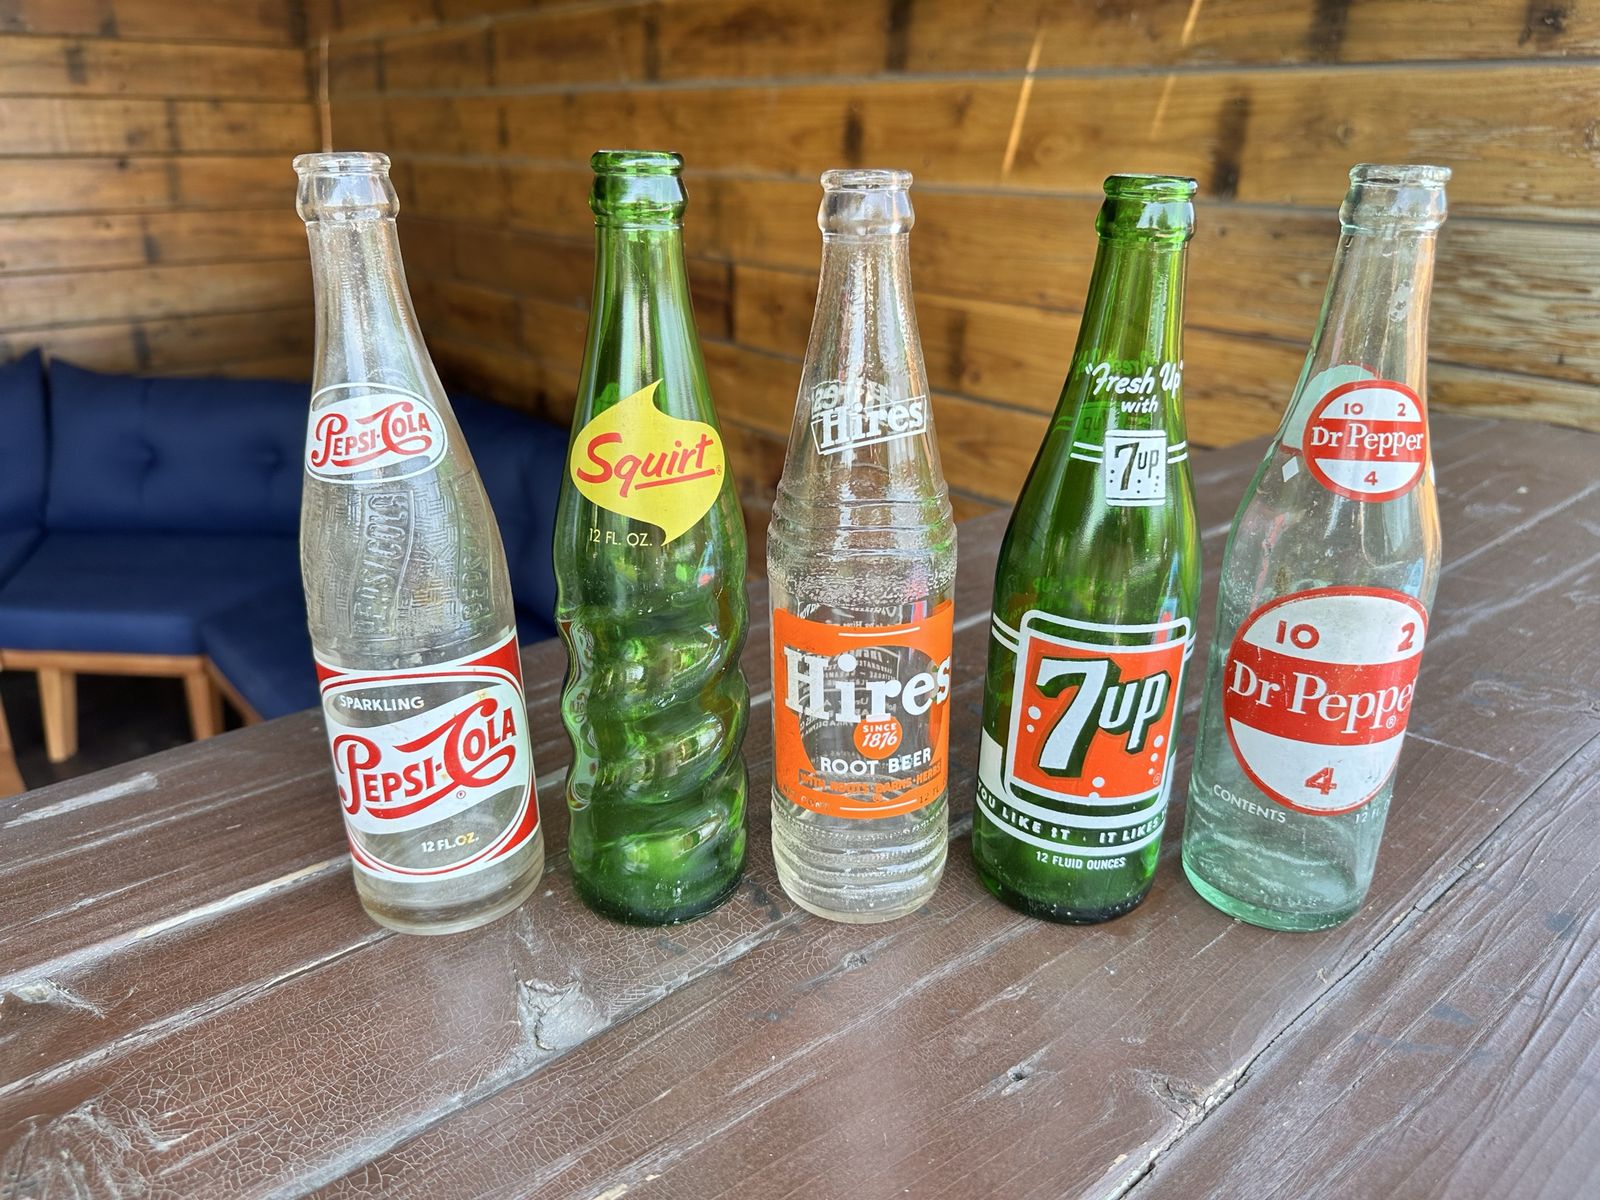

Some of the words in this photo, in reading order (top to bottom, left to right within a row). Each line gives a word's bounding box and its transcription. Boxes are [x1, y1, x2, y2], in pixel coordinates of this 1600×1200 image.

[1120, 394, 1158, 413] with
[1343, 402, 1364, 415] 10
[1396, 403, 1406, 417] 2
[820, 401, 923, 449] Hires
[1310, 425, 1343, 447] Dr
[1347, 423, 1424, 457] Pepper
[576, 432, 714, 498] Squirt
[1363, 471, 1378, 486] 4
[589, 528, 601, 543] 12
[605, 531, 621, 546] FL.
[626, 532, 653, 547] OZ.
[1276, 620, 1320, 649] 10
[1397, 621, 1416, 653] 2
[784, 646, 951, 723] Hires
[1229, 659, 1280, 708] Dr
[340, 695, 425, 712] SPARKLING
[862, 722, 897, 733] SINCE
[861, 732, 898, 750] 1876
[820, 756, 880, 776] ROOT
[888, 747, 931, 774] BEER
[1304, 767, 1337, 796] 4
[1213, 784, 1287, 824] CONTENTS
[1002, 806, 1041, 834] LIKE
[1099, 832, 1117, 844] IT
[1122, 816, 1159, 842] LIKES
[1355, 811, 1368, 824] 12
[421, 841, 435, 853] 12
[1036, 851, 1049, 863] 12
[1052, 855, 1083, 870] FLUID
[1087, 857, 1127, 870] OUNCES
